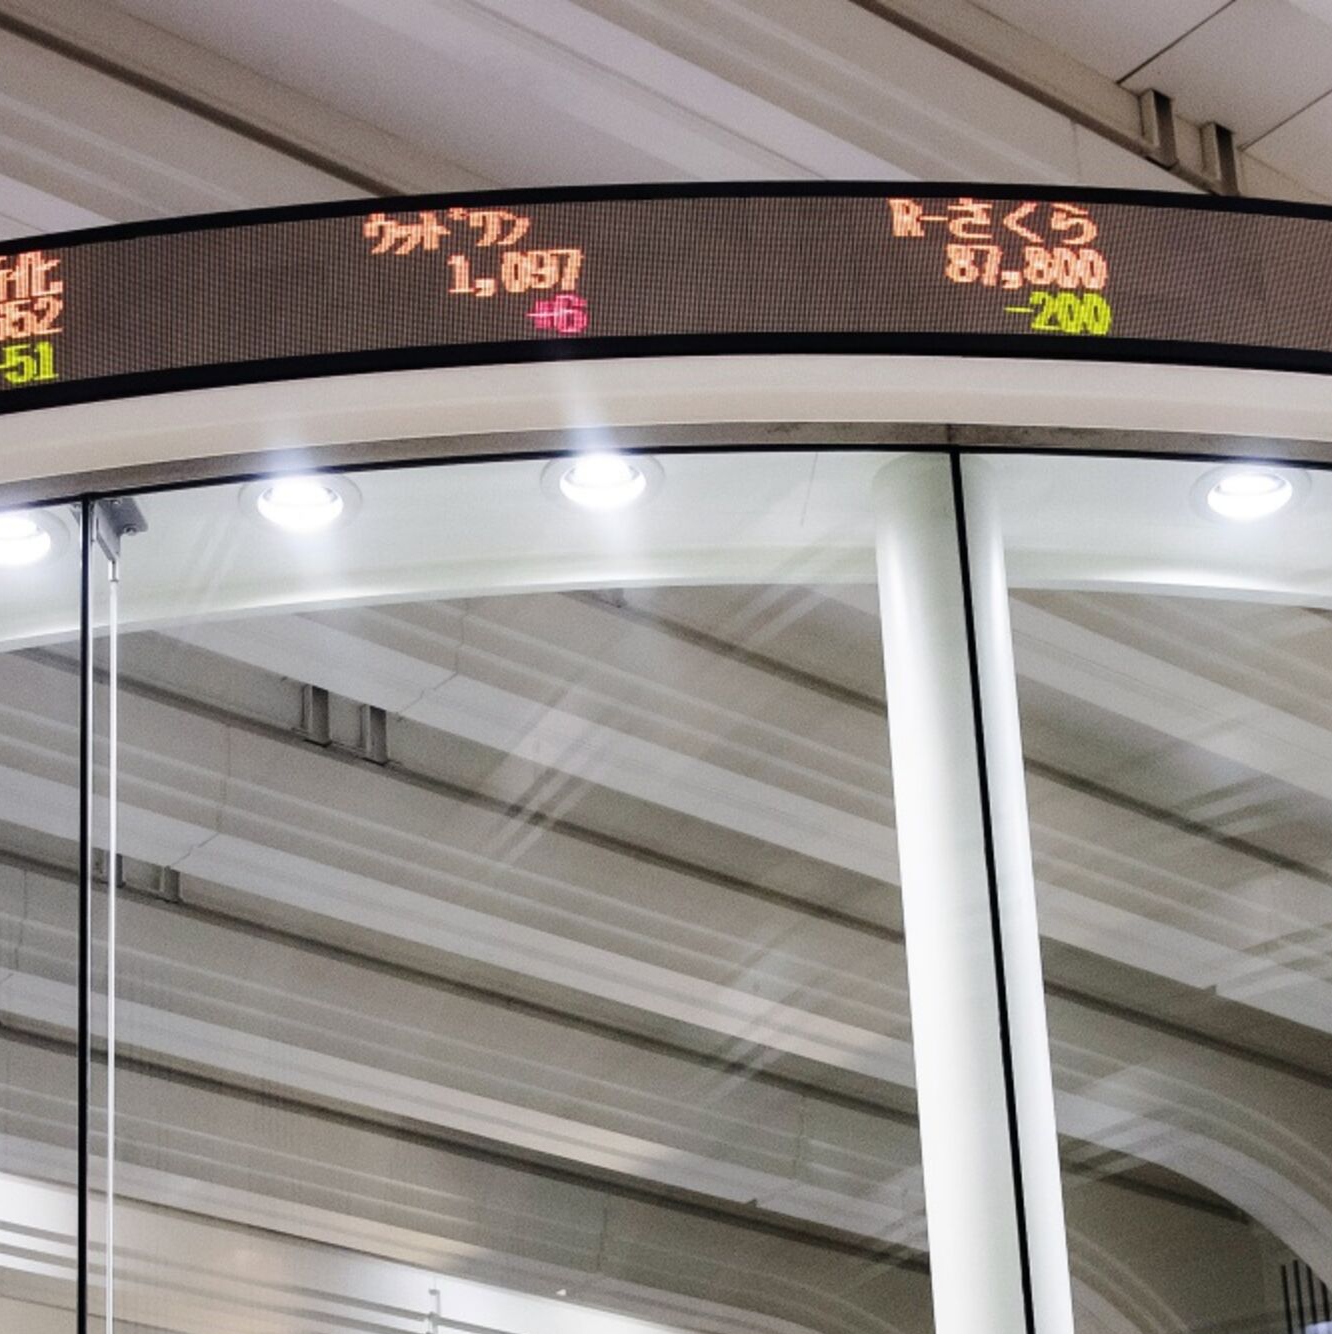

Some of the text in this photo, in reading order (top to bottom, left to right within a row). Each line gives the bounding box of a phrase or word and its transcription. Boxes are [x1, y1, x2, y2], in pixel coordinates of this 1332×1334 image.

[889, 197, 1098, 245] R-さくら
[447, 248, 584, 297] 1,097
[1004, 291, 1112, 336] -200
